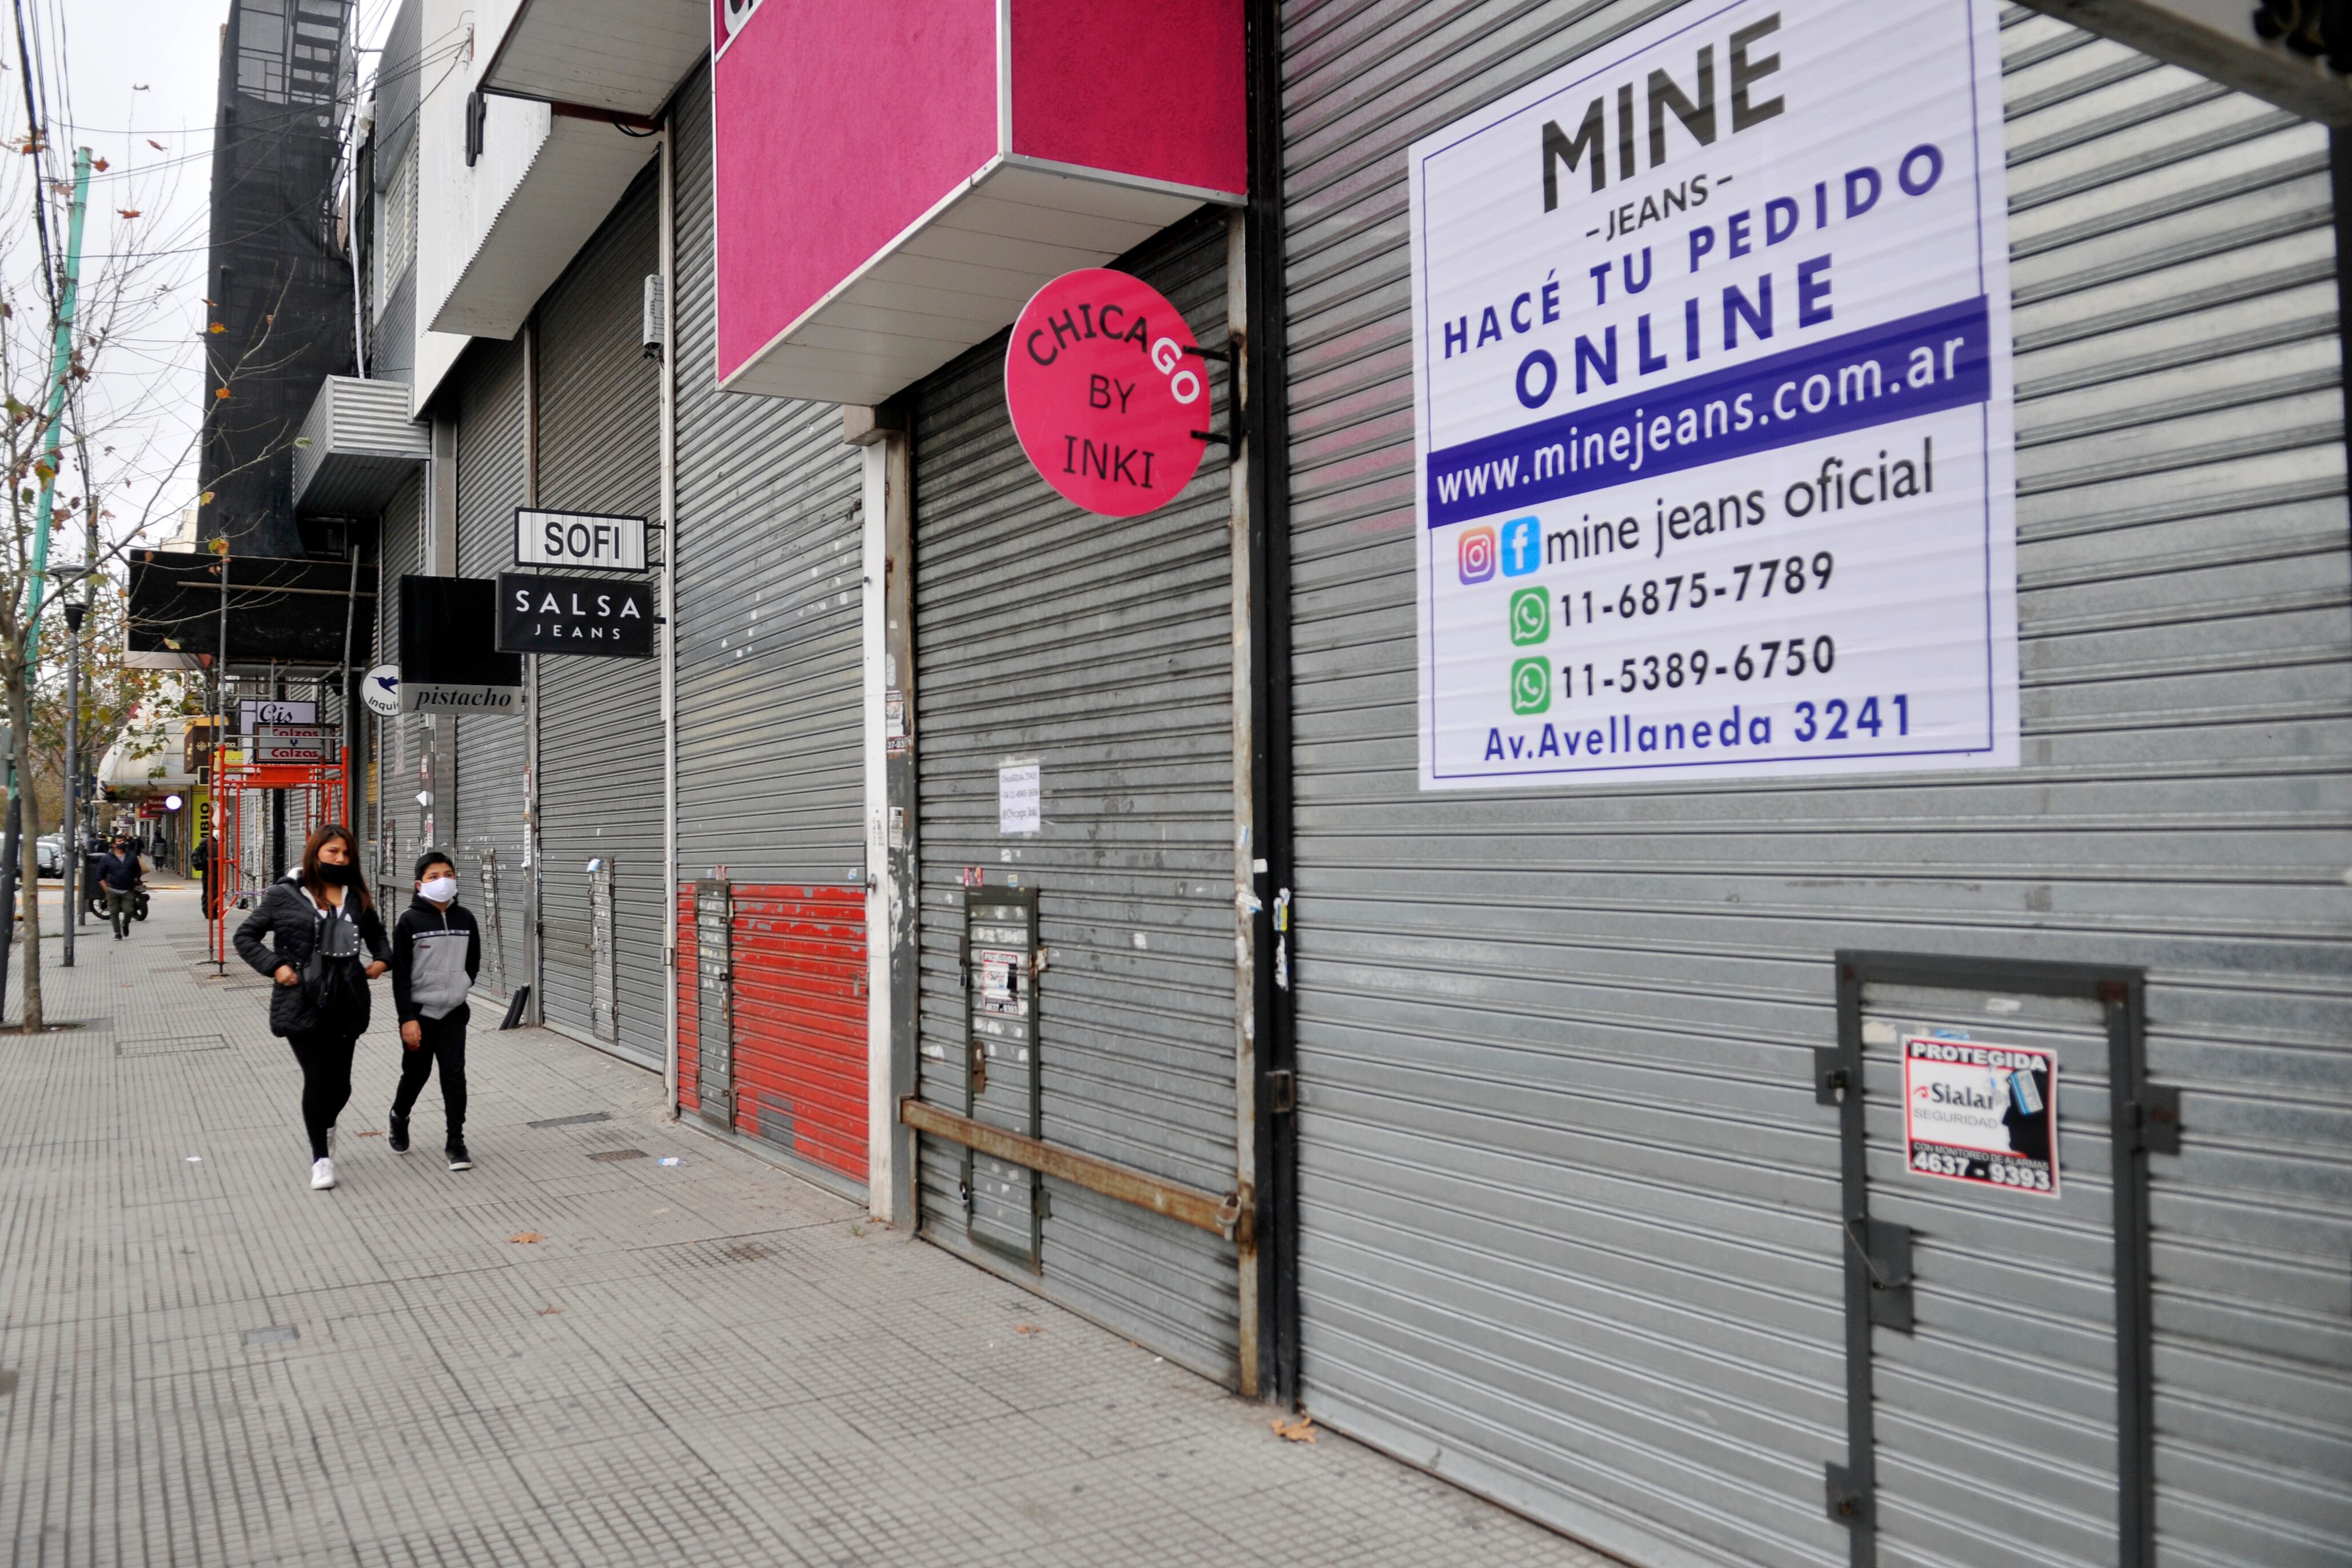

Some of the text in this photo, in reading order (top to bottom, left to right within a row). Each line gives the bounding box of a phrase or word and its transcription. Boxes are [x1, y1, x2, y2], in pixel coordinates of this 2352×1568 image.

[1541, 11, 1785, 213] MINE
[1444, 143, 1944, 359] HACÉ TU PEDIDO
[1515, 253, 1834, 409] ONLINE
[1027, 304, 1200, 404] CHICAGO
[1090, 373, 1135, 414] BY
[1437, 335, 1964, 504] www.minejeans.com.ar
[1063, 434, 1154, 489] INKI
[1546, 514, 1640, 565] mine
[1655, 489, 1766, 559] jeans
[1785, 436, 1934, 518] oficial
[544, 521, 619, 559] SOFI
[516, 590, 640, 619] SALSA
[1560, 550, 1833, 627] 11-6875-7789
[535, 624, 620, 640] JEANS
[1561, 634, 1835, 699] 11-5389-6750
[368, 696, 398, 711] Inqui
[413, 686, 511, 711] pistacho
[1484, 693, 1909, 761] Av.Avellaneda 3241
[271, 748, 318, 757] Calzas
[1911, 1042, 2047, 1072] PROTEGIDA
[1913, 1108, 1998, 1130] SEGURIDAD
[1914, 1151, 1970, 1176] 4637
[1988, 1163, 2051, 1191] 9393
[1915, 1142, 2050, 1171] CON MONITOREO DE ALARMAS
